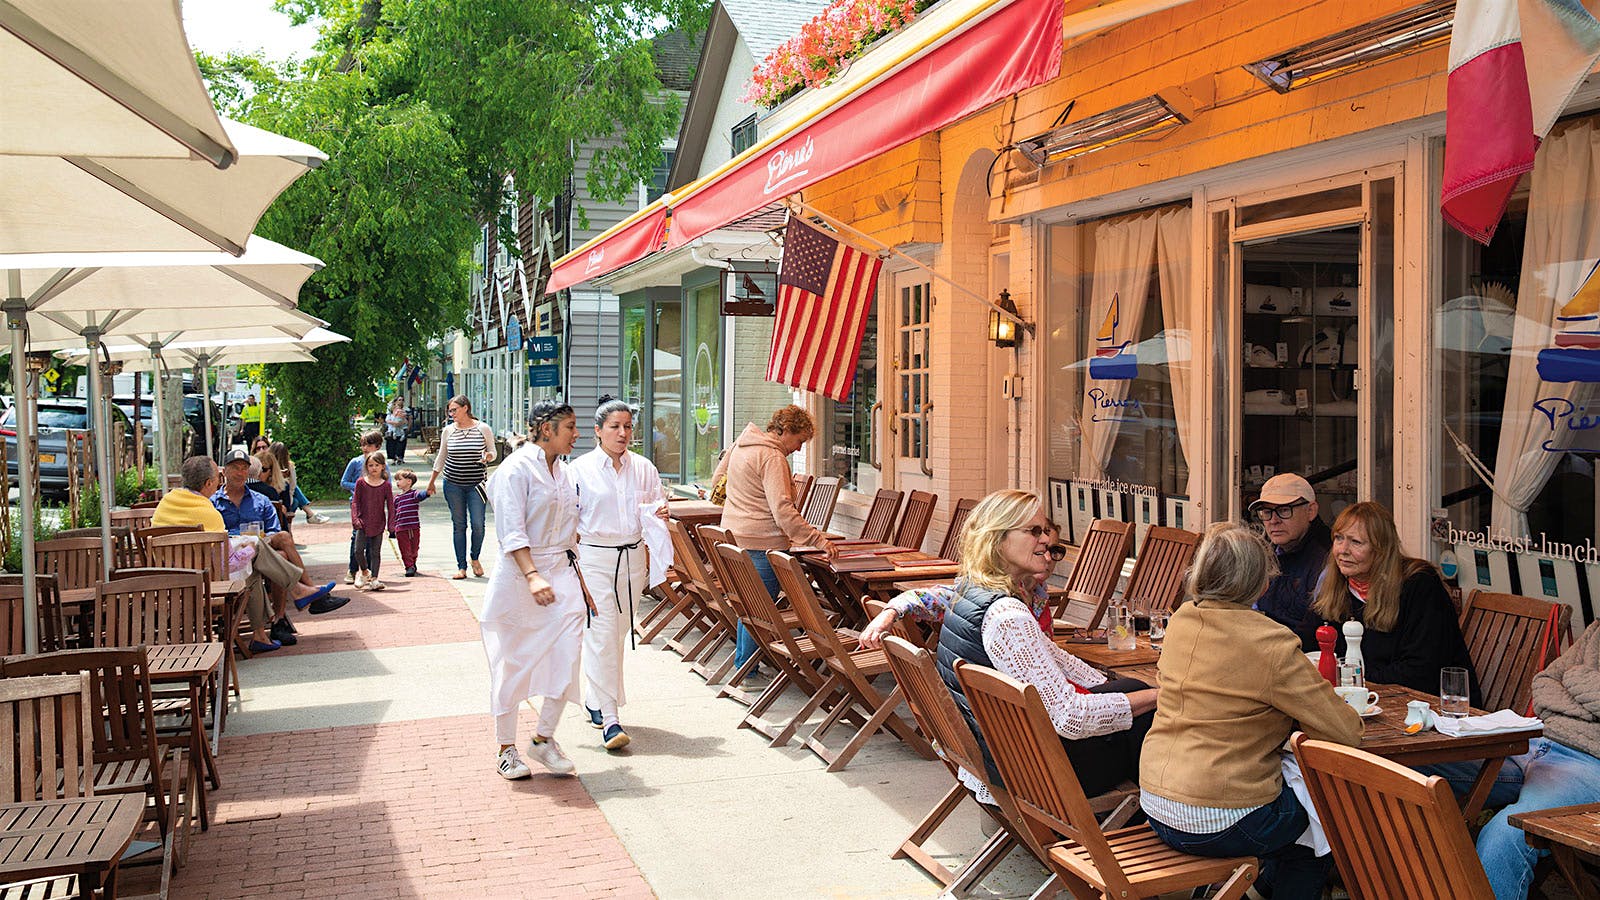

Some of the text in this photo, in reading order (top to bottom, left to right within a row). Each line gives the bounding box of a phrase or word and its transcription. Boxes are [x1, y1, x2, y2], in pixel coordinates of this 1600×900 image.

[1072, 472, 1157, 497] homemade ice cream
[1447, 521, 1599, 565] breakfast lunch
